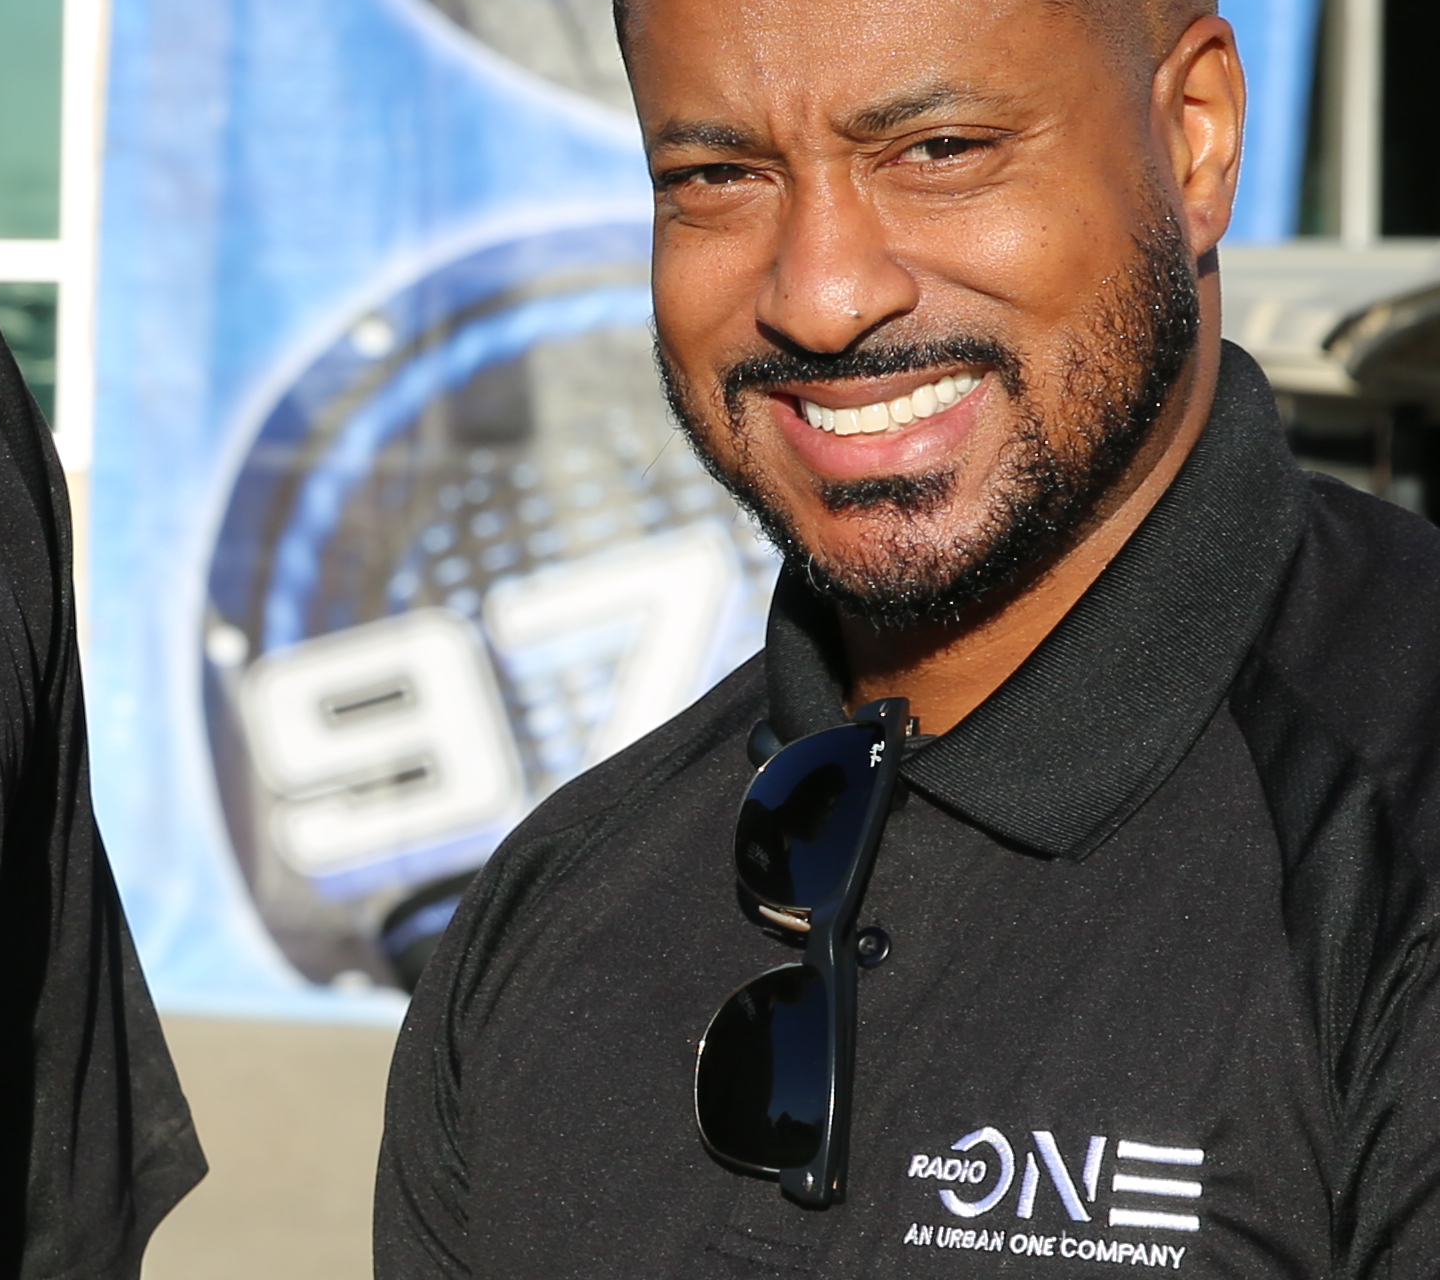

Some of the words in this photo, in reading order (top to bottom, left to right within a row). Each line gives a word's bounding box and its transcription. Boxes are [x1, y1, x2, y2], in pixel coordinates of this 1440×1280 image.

[907, 1154, 987, 1184] RADIO
[939, 1126, 1205, 1232] ONE
[903, 1222, 934, 1247] AN
[936, 1227, 1005, 1253] URBAN
[1009, 1233, 1055, 1258] ONE
[1060, 1236, 1187, 1270] COMPANY
